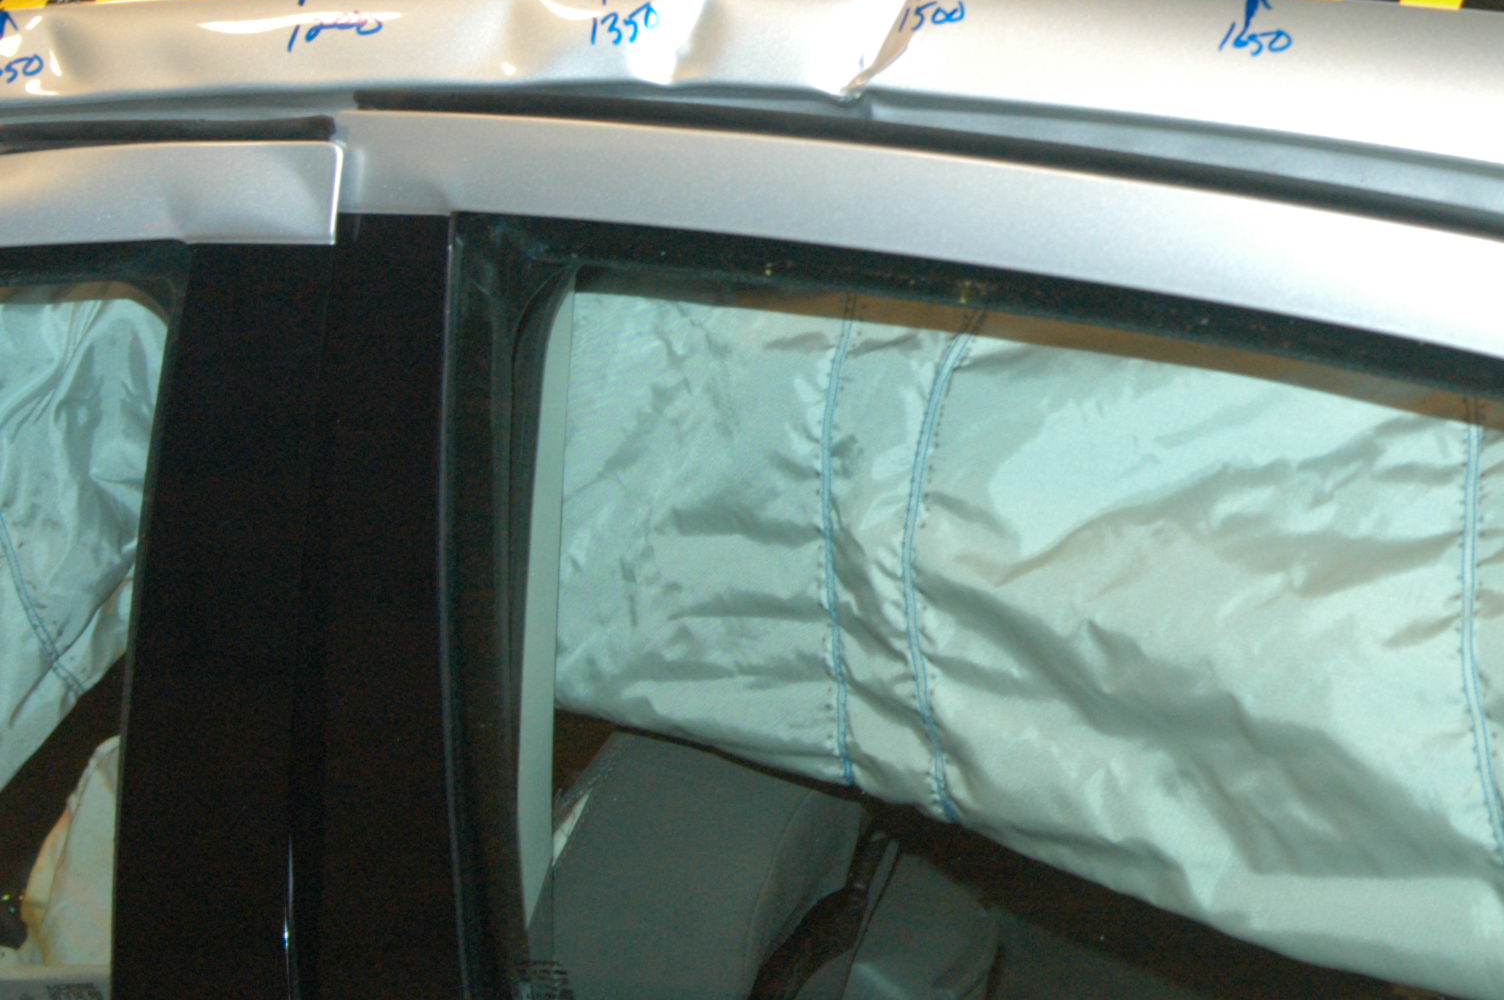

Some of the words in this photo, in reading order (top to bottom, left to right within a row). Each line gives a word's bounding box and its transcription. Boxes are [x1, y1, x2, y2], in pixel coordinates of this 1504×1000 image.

[590, 1, 661, 45] 1350
[898, 0, 967, 32] 1500
[1218, 21, 1293, 57] 1650
[0, 53, 44, 84] 50
